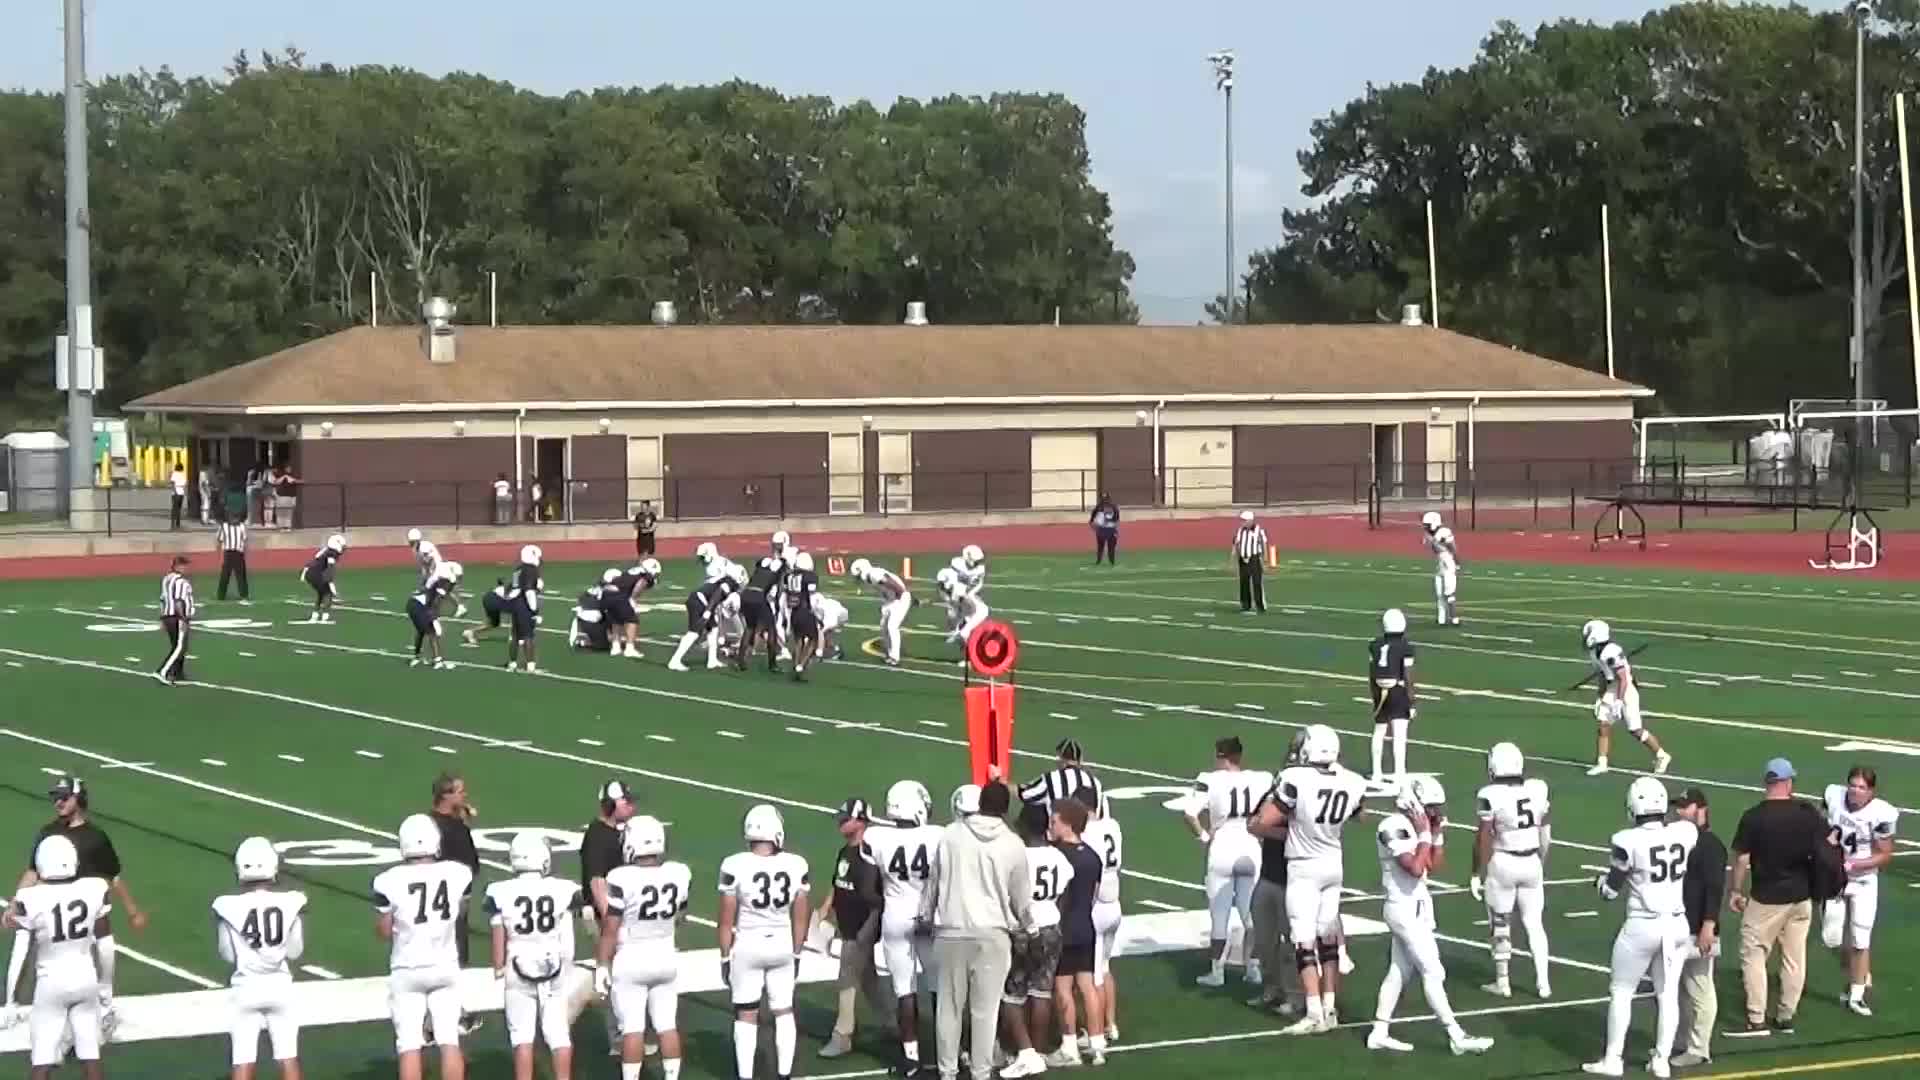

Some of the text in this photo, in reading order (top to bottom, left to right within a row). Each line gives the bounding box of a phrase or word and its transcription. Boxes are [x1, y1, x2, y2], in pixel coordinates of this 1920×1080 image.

[1378, 644, 1390, 667] 1
[1228, 786, 1251, 818] 11
[1315, 788, 1349, 825] 70
[1517, 798, 1534, 829] 5
[889, 843, 930, 881] 44
[1650, 843, 1687, 883] 52
[752, 871, 791, 909] 33
[1032, 864, 1058, 901] 51
[52, 899, 89, 943] 12
[408, 880, 451, 924] 74
[514, 895, 555, 935] 38
[638, 883, 678, 921] 23
[240, 907, 283, 950] 40
